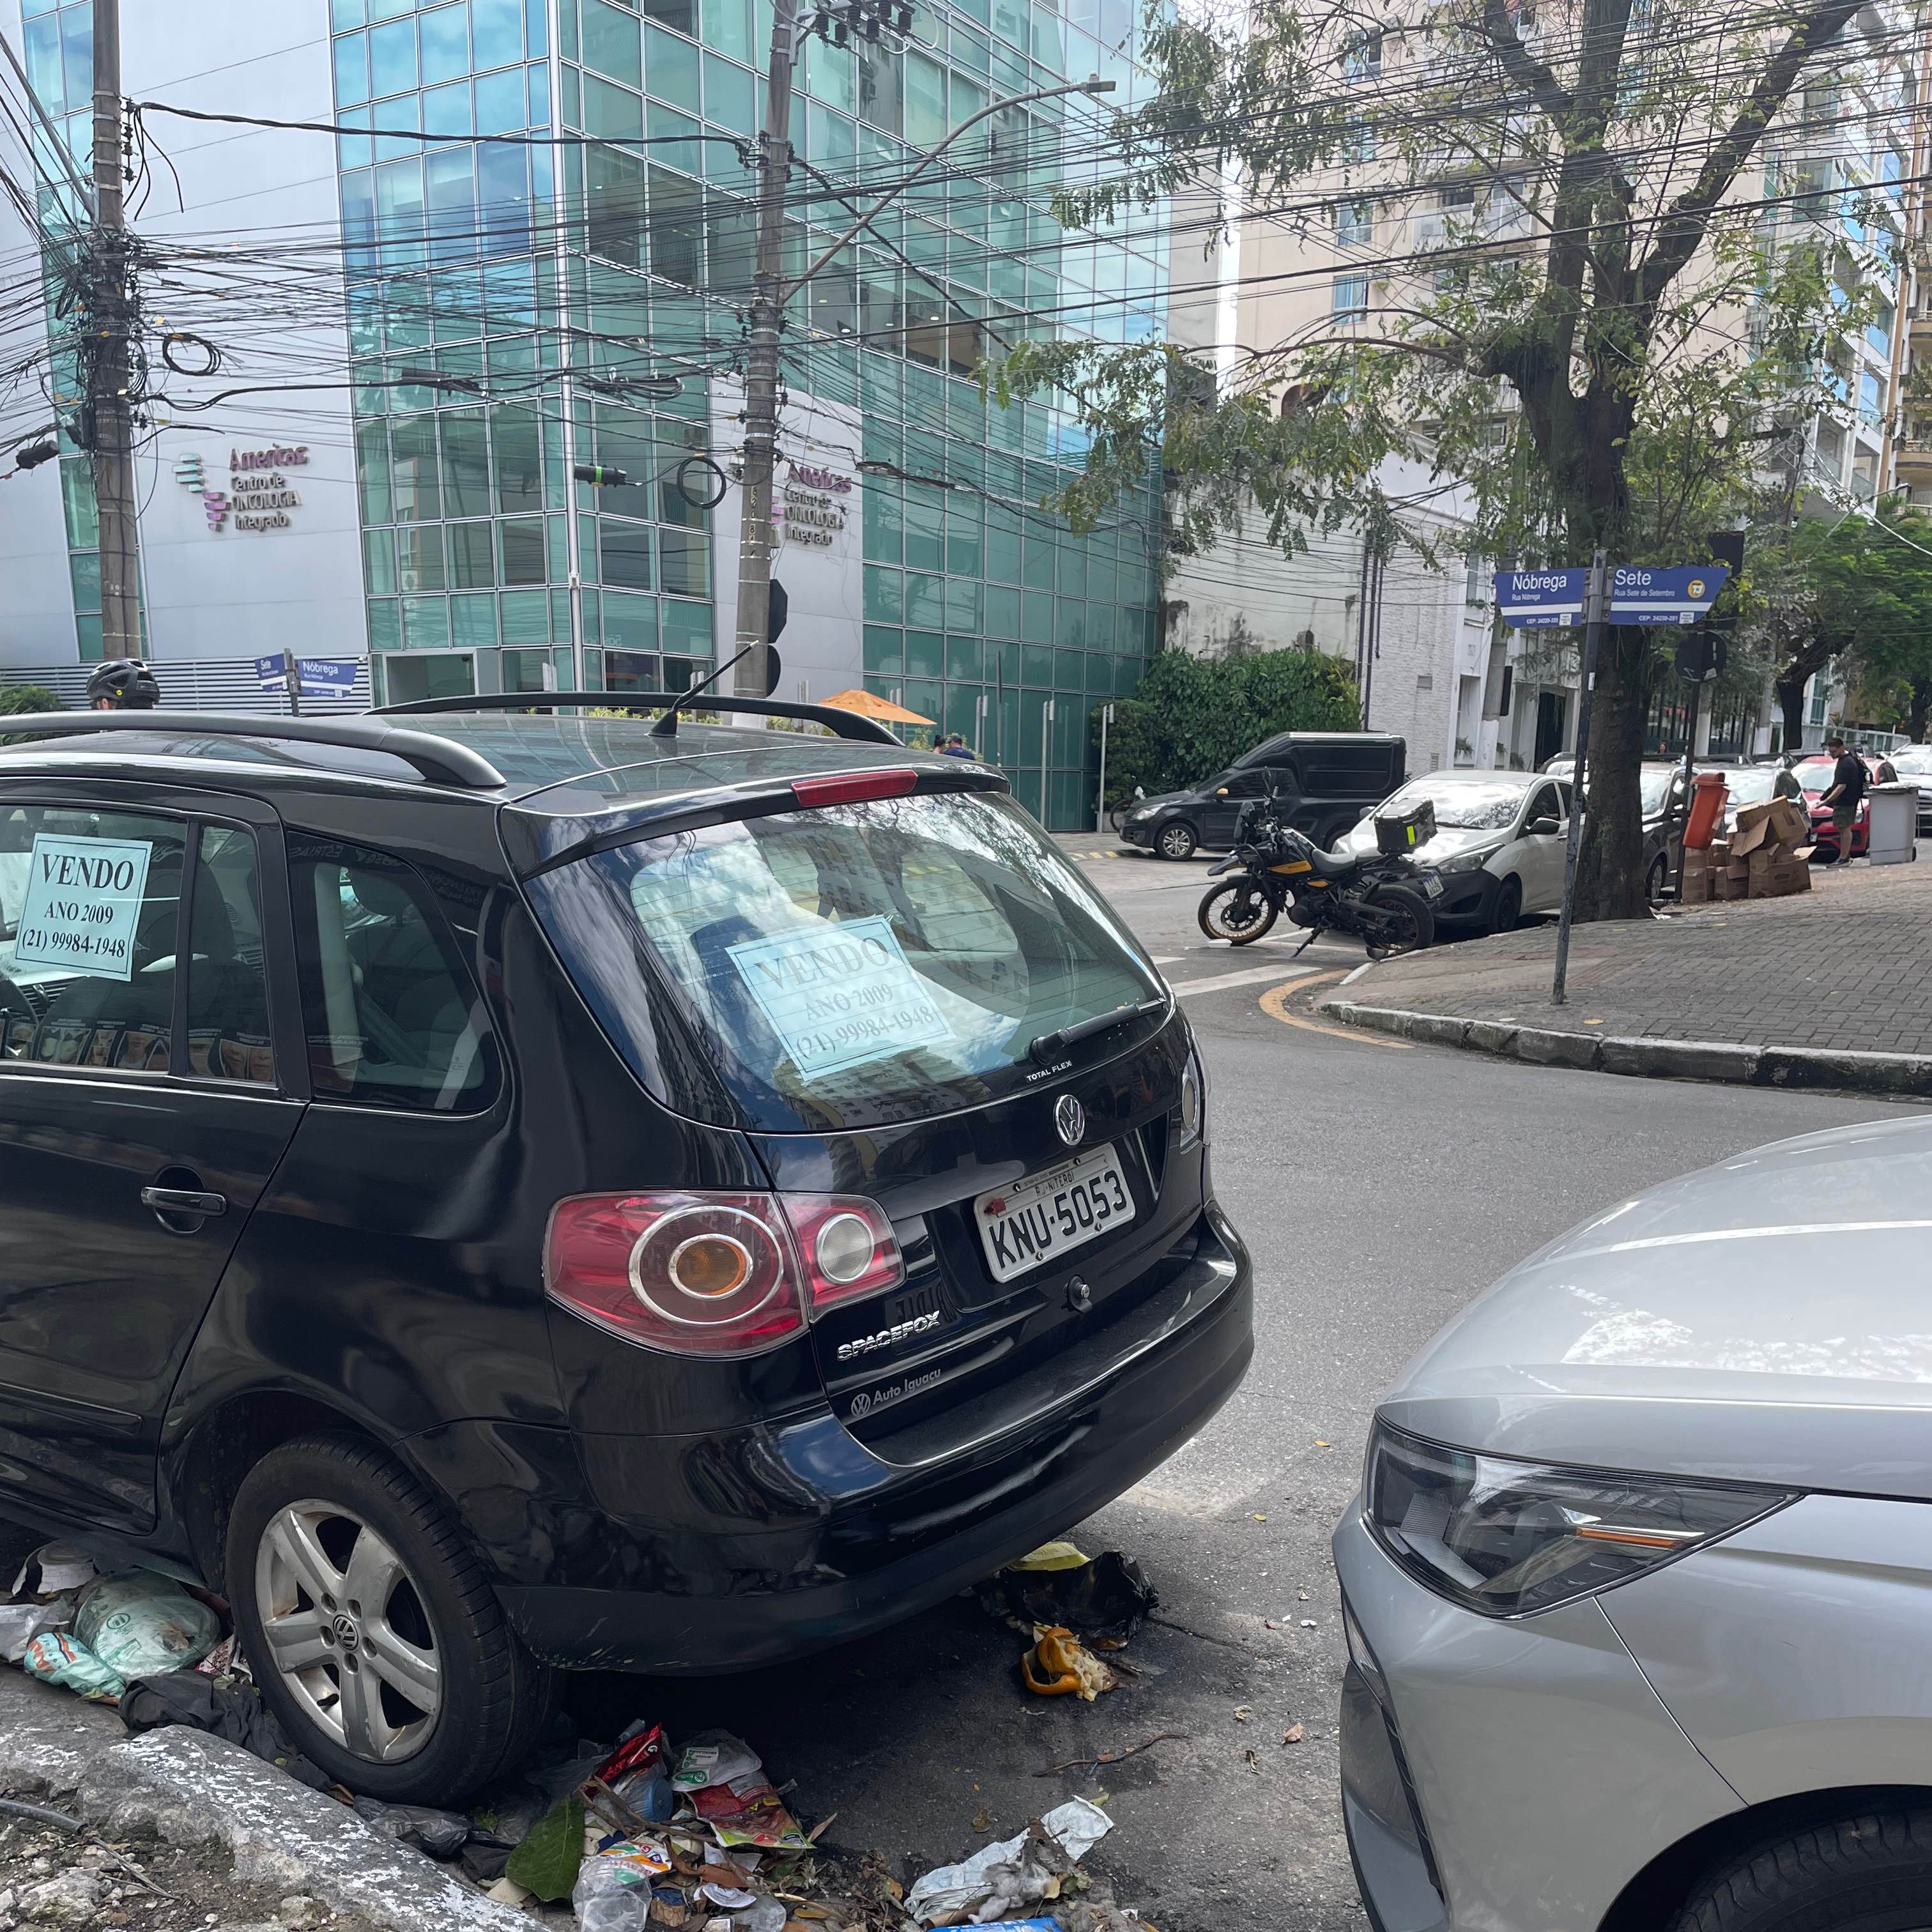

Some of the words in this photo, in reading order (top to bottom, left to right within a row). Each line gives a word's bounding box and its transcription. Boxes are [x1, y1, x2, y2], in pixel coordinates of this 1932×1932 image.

[230, 443, 309, 471] Americas
[231, 476, 266, 491] Centro
[268, 471, 286, 489] de
[231, 490, 303, 511] ONCOLOGIA
[234, 511, 291, 531] Integrado
[1512, 574, 1567, 592] Nóbrega
[1614, 569, 1652, 586] Sete
[1648, 588, 1676, 597] Setembro
[260, 659, 272, 670] Sete
[302, 661, 339, 677] Nóbrega
[42, 853, 134, 891] VENDO
[43, 900, 79, 921] ANO
[80, 904, 114, 924] 2009
[22, 928, 47, 952] (21)
[50, 931, 125, 958] 99984-1948
[754, 937, 890, 990] VENDO
[805, 992, 852, 1022] ANO
[857, 983, 894, 1008] 2009
[796, 1031, 837, 1060] (21)
[836, 1006, 935, 1046] 99984-1948
[1026, 1069, 1052, 1082] TOTAL
[1052, 1060, 1073, 1073] FLEX
[837, 1310, 940, 1362] SPACEFOX
[873, 1386, 901, 1405] Auto
